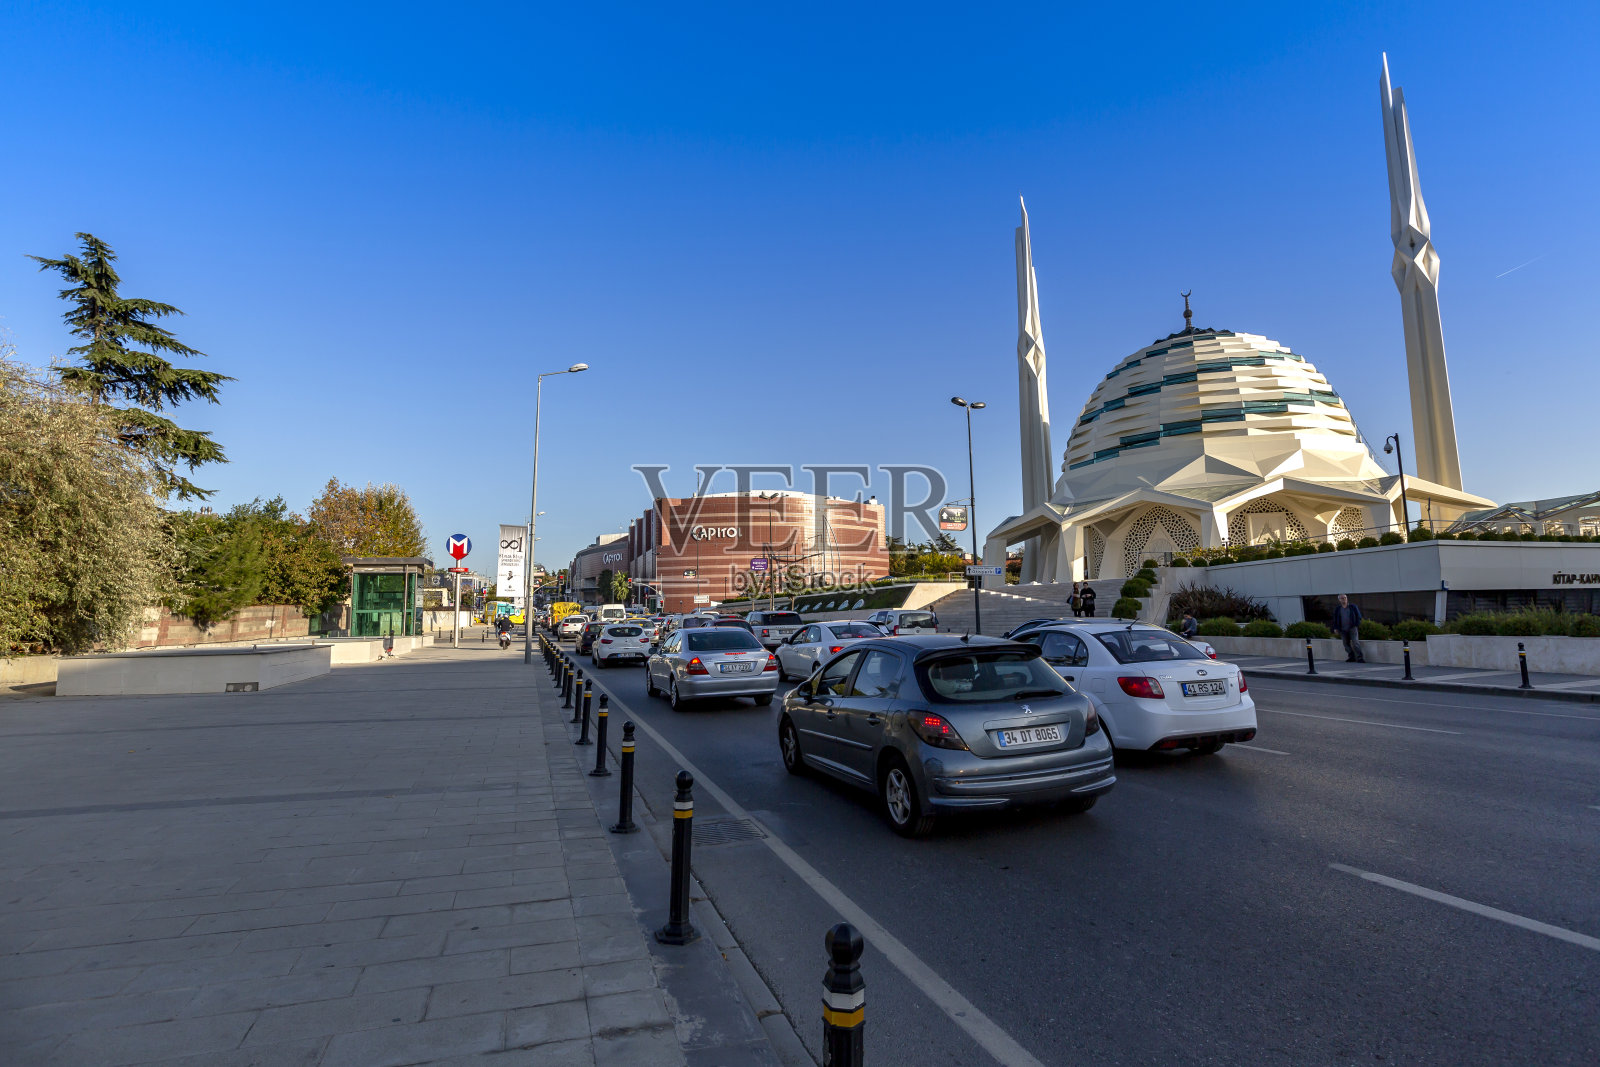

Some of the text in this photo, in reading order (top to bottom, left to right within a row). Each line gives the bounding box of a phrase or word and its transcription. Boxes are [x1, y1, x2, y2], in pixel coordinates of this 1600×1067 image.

[692, 525, 742, 541] CAPITOL
[449, 536, 468, 554] M
[1187, 682, 1223, 694] 41 RS 124
[1004, 728, 1059, 744] 34 DT 8065
